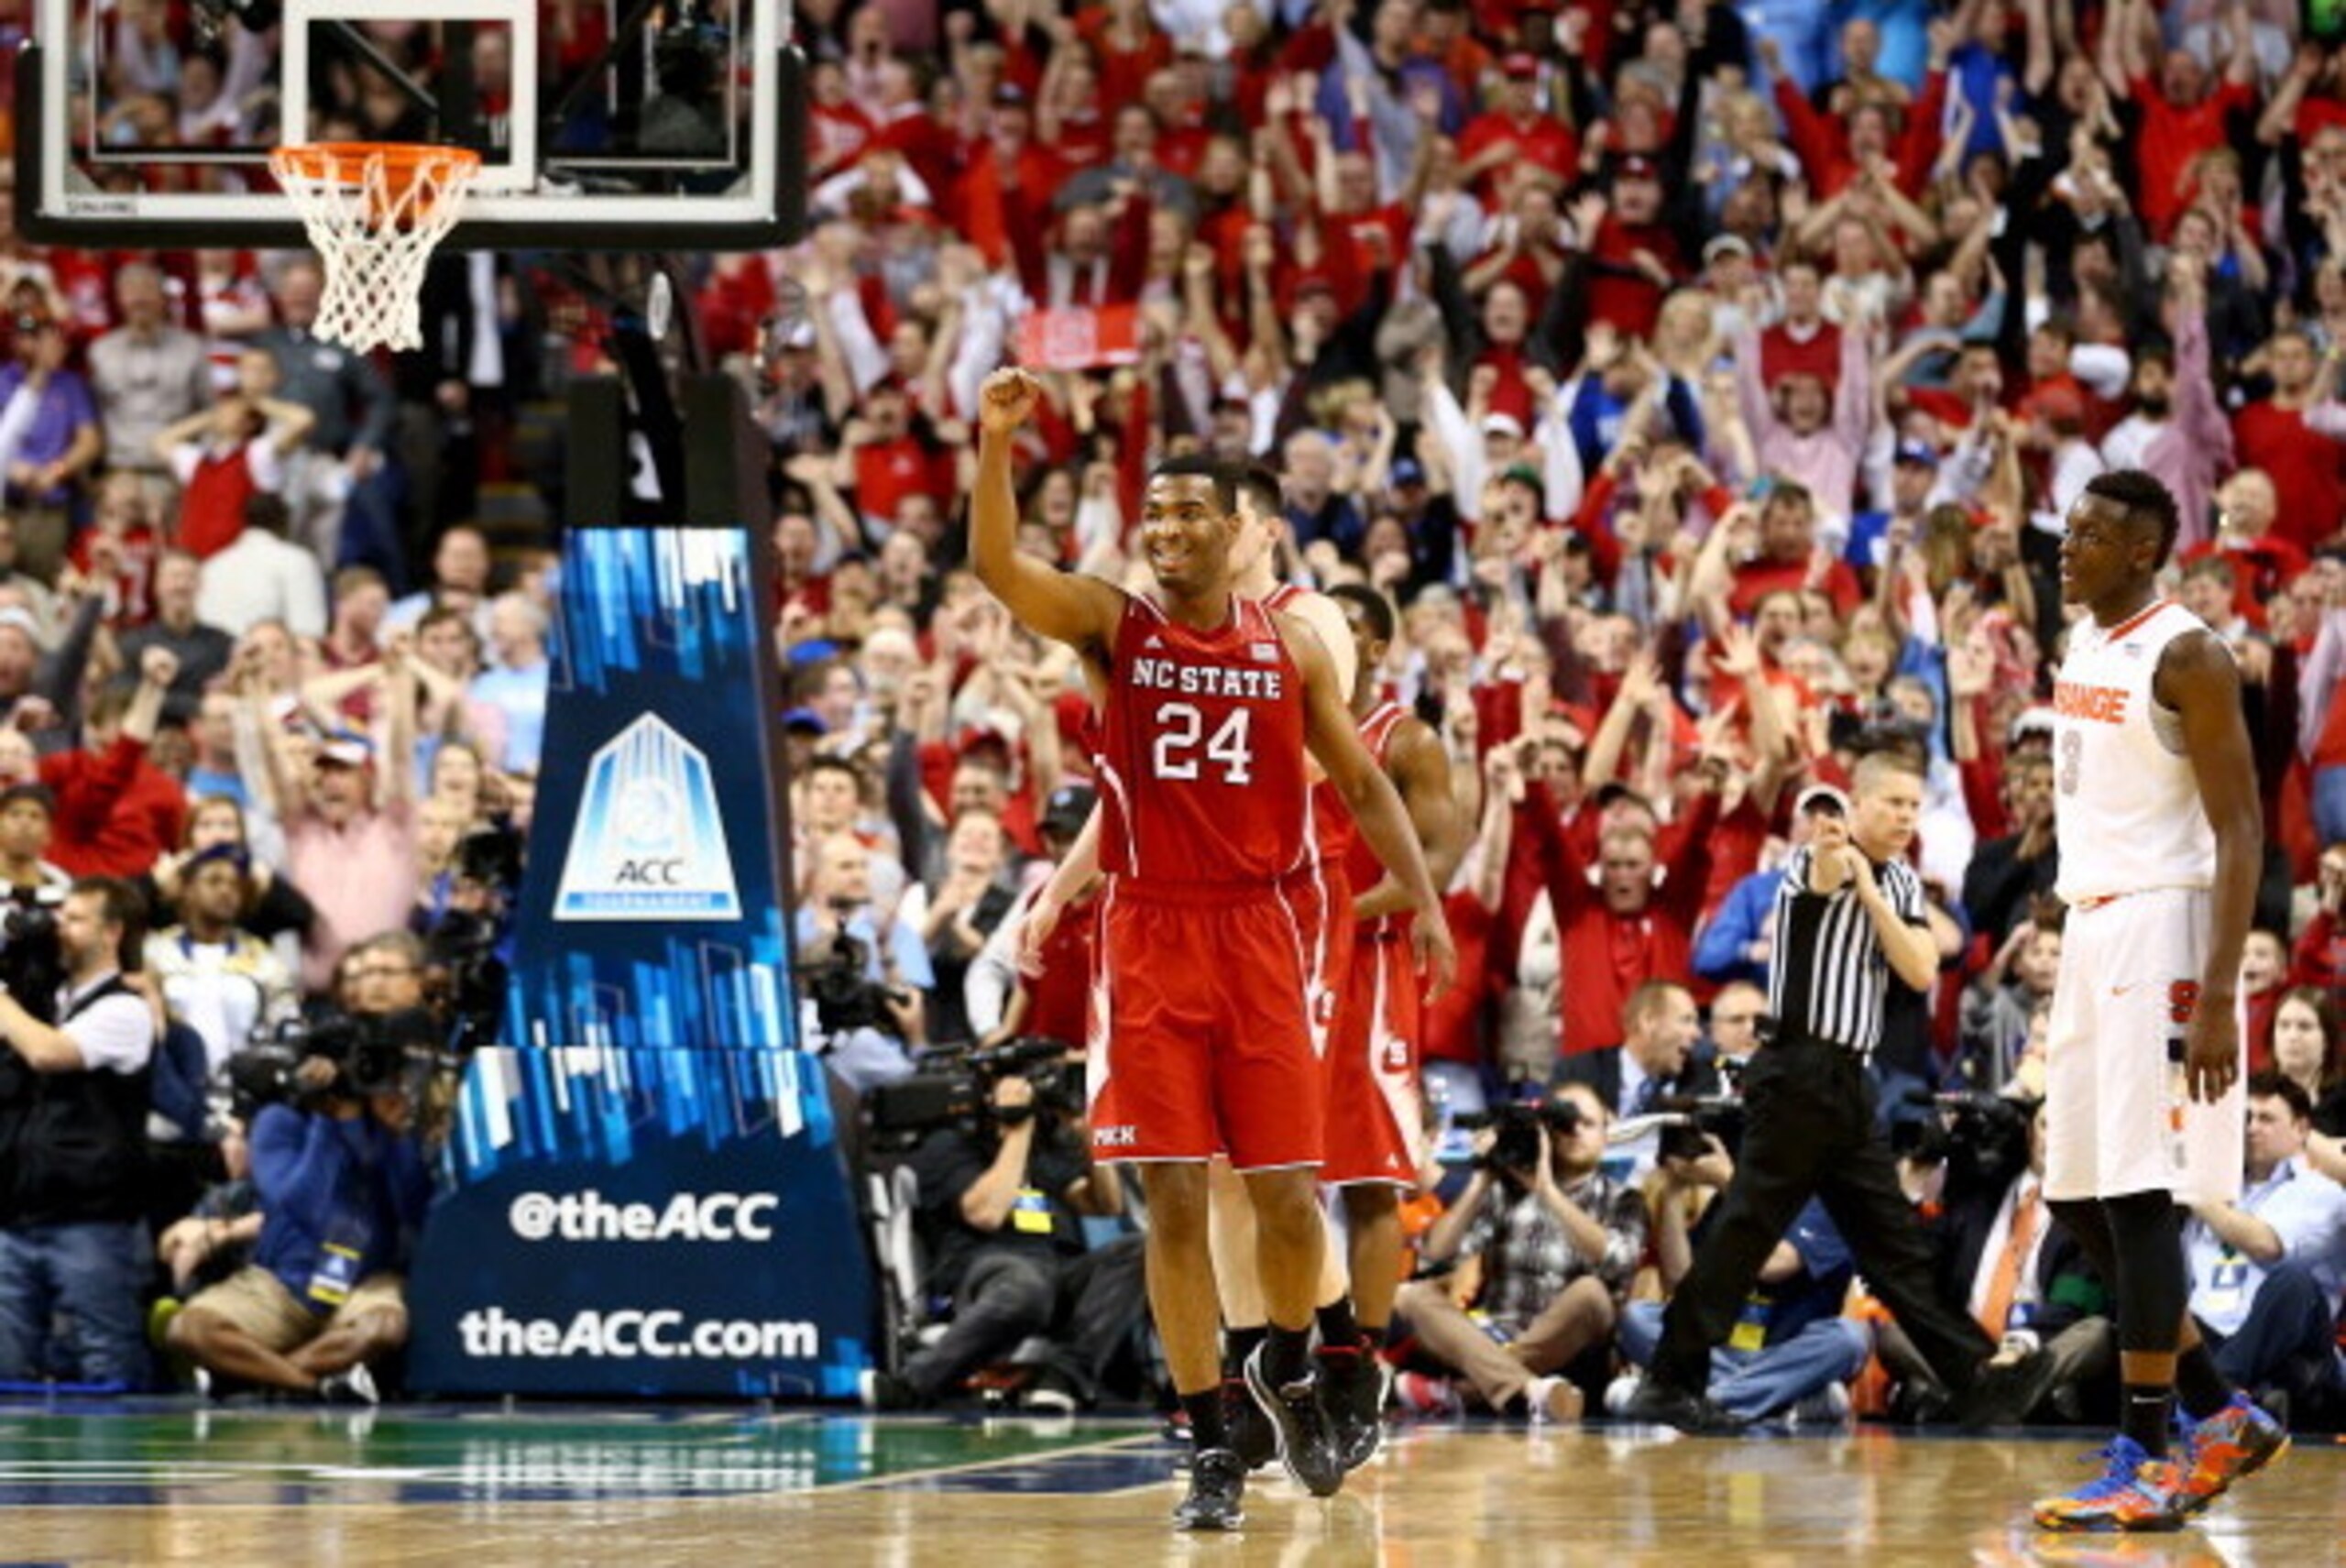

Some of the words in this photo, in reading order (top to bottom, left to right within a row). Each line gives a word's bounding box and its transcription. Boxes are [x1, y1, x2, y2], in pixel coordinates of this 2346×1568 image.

[1132, 658, 1175, 687] NC
[1179, 666, 1281, 699] STATE
[2054, 680, 2130, 723] RANGE
[1154, 702, 1252, 784] 24
[615, 859, 685, 886] ACC
[508, 1189, 779, 1241] @theACC
[458, 1306, 818, 1358] theACC.com
